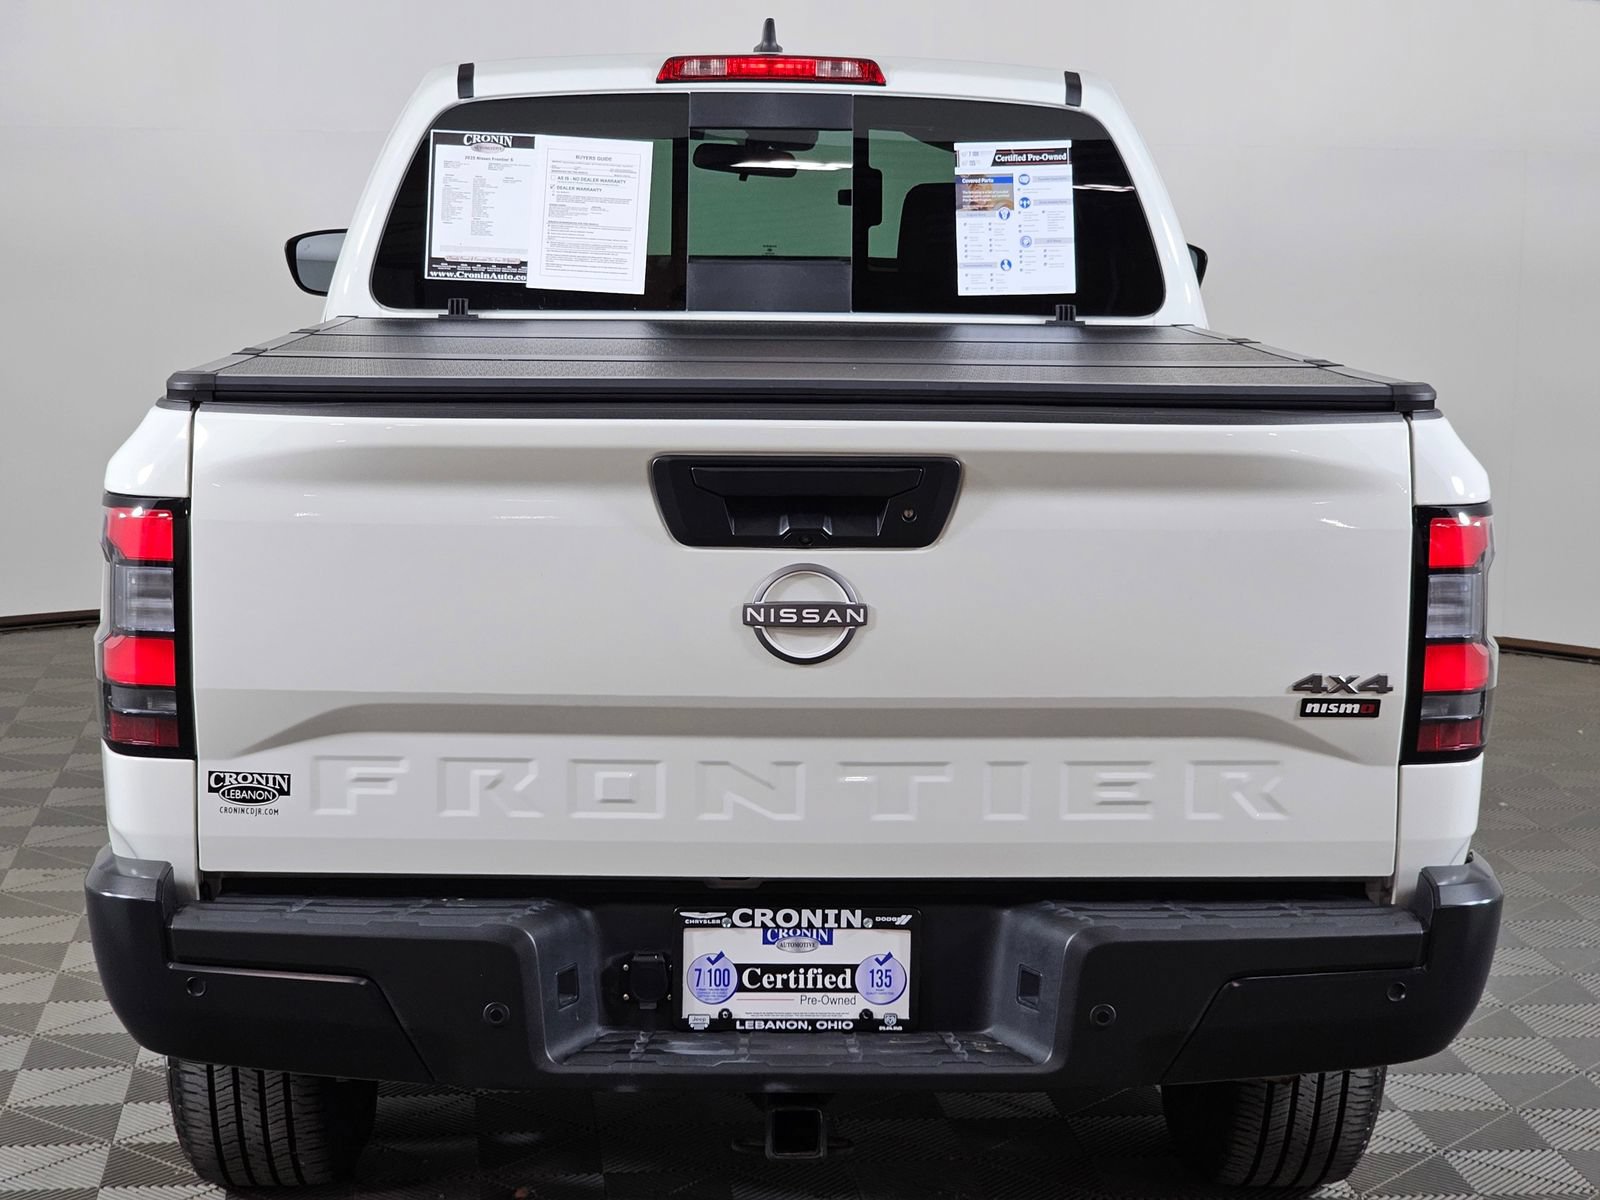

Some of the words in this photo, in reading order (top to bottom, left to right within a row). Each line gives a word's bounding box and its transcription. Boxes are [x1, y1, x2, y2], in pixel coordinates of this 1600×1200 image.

[463, 133, 513, 148] CRONIN
[995, 154, 1026, 162] Certified
[1027, 152, 1067, 162] Pre-Owned
[430, 271, 527, 281] www.CroninAuto.co
[746, 607, 865, 623] NISSAN
[1289, 673, 1394, 694] 4X4
[209, 772, 289, 792] CRONIN
[311, 755, 1289, 821] FRONTIER
[224, 789, 273, 800] LEBANON
[219, 806, 280, 817] CRONINCDJR.COM
[731, 908, 862, 928] CRONIN
[766, 928, 829, 943] CRONIN
[741, 967, 853, 989] Certified
[869, 968, 893, 989] 135
[800, 994, 857, 1006] Pre-Owned
[736, 1020, 812, 1031] LEBANON,
[816, 1020, 854, 1030] OHIO
